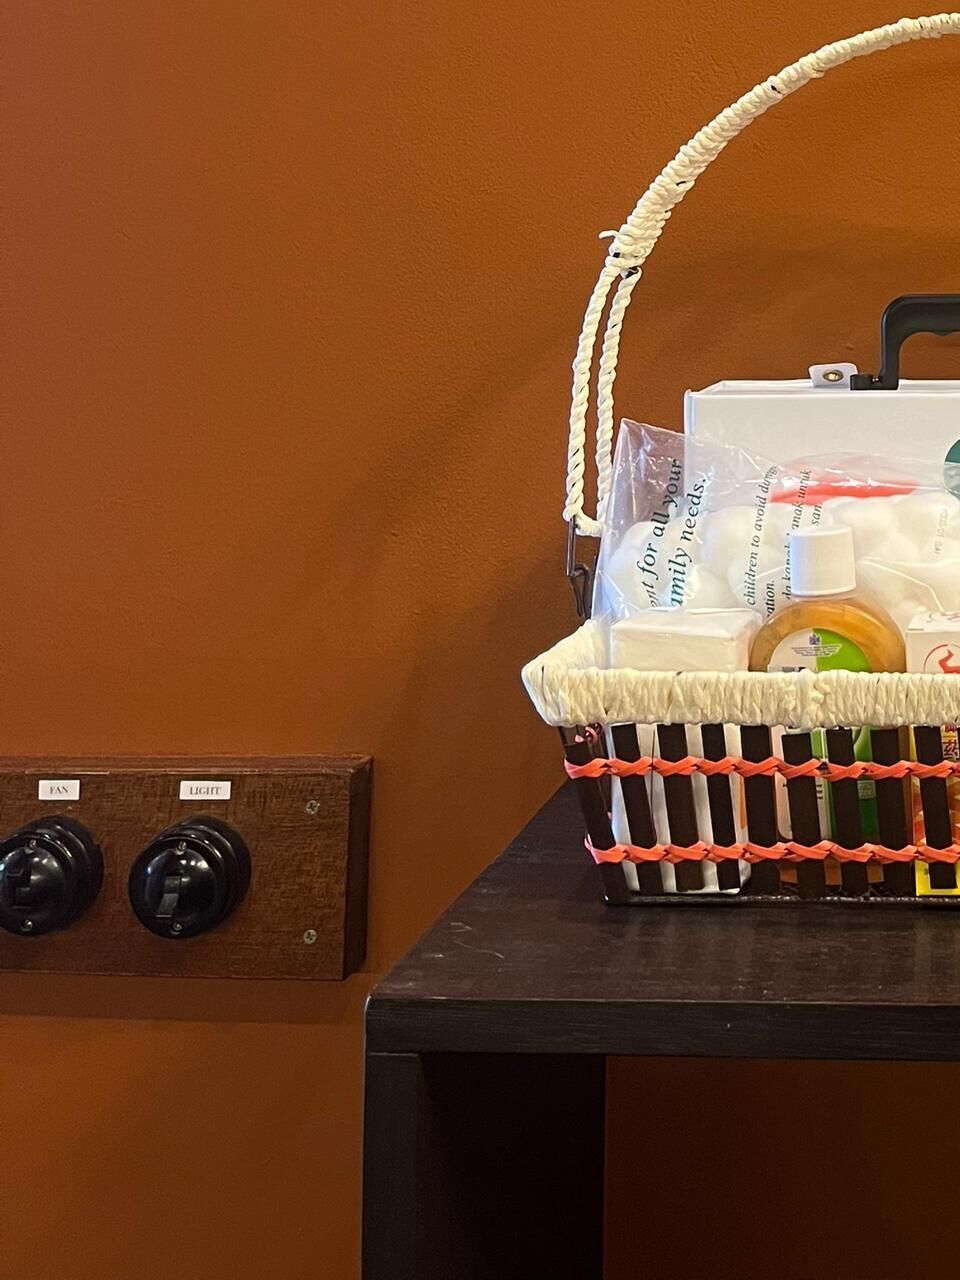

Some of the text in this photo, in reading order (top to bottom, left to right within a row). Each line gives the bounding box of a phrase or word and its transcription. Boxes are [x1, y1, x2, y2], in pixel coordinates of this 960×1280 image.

[636, 543, 659, 581] for
[650, 511, 671, 538] all
[662, 458, 683, 508] your
[679, 477, 707, 543] needs.
[743, 494, 768, 606] children to avoid
[49, 785, 222, 796] FAN LIGHT
